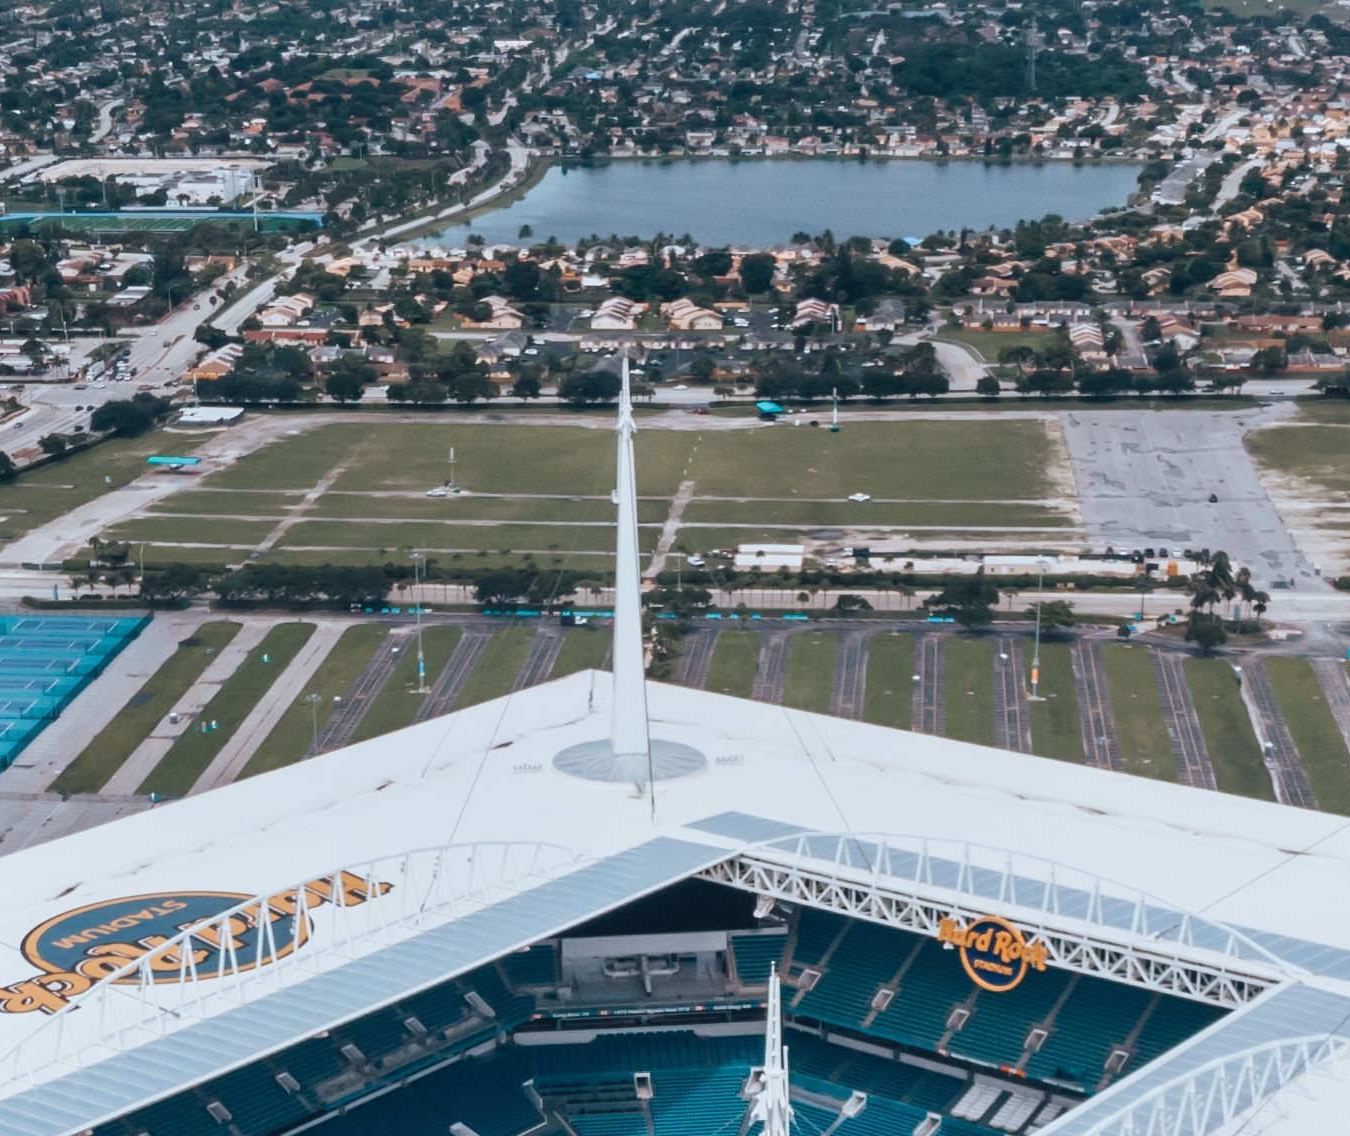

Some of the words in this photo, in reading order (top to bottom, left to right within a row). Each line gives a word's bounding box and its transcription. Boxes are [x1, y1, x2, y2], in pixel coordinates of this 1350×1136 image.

[50, 899, 188, 950] STADIUM
[176, 870, 395, 951] Hard
[938, 918, 994, 952] Hard
[993, 931, 1048, 971] Rock
